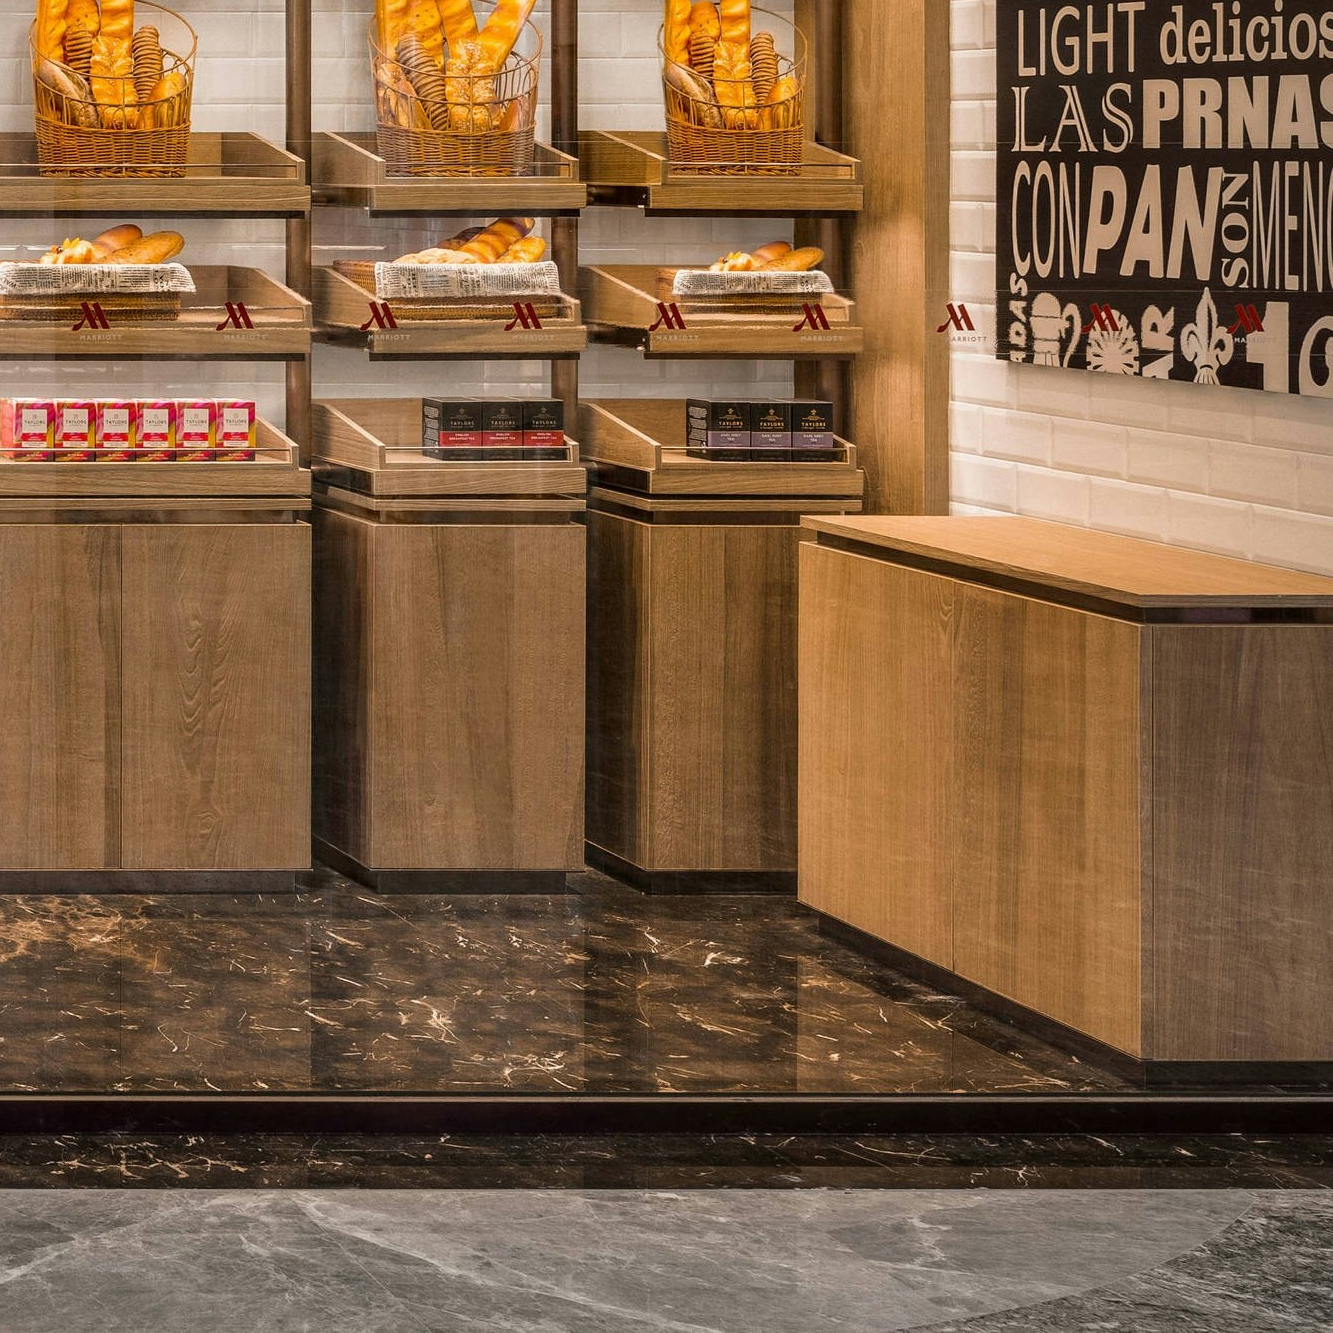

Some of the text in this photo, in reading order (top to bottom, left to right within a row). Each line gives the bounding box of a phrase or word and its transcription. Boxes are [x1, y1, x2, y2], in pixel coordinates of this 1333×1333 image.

[1017, 0, 1146, 77] LIGHT
[1010, 82, 1134, 153] LAS
[1011, 160, 1081, 280] CON
[1082, 164, 1225, 282] PAN
